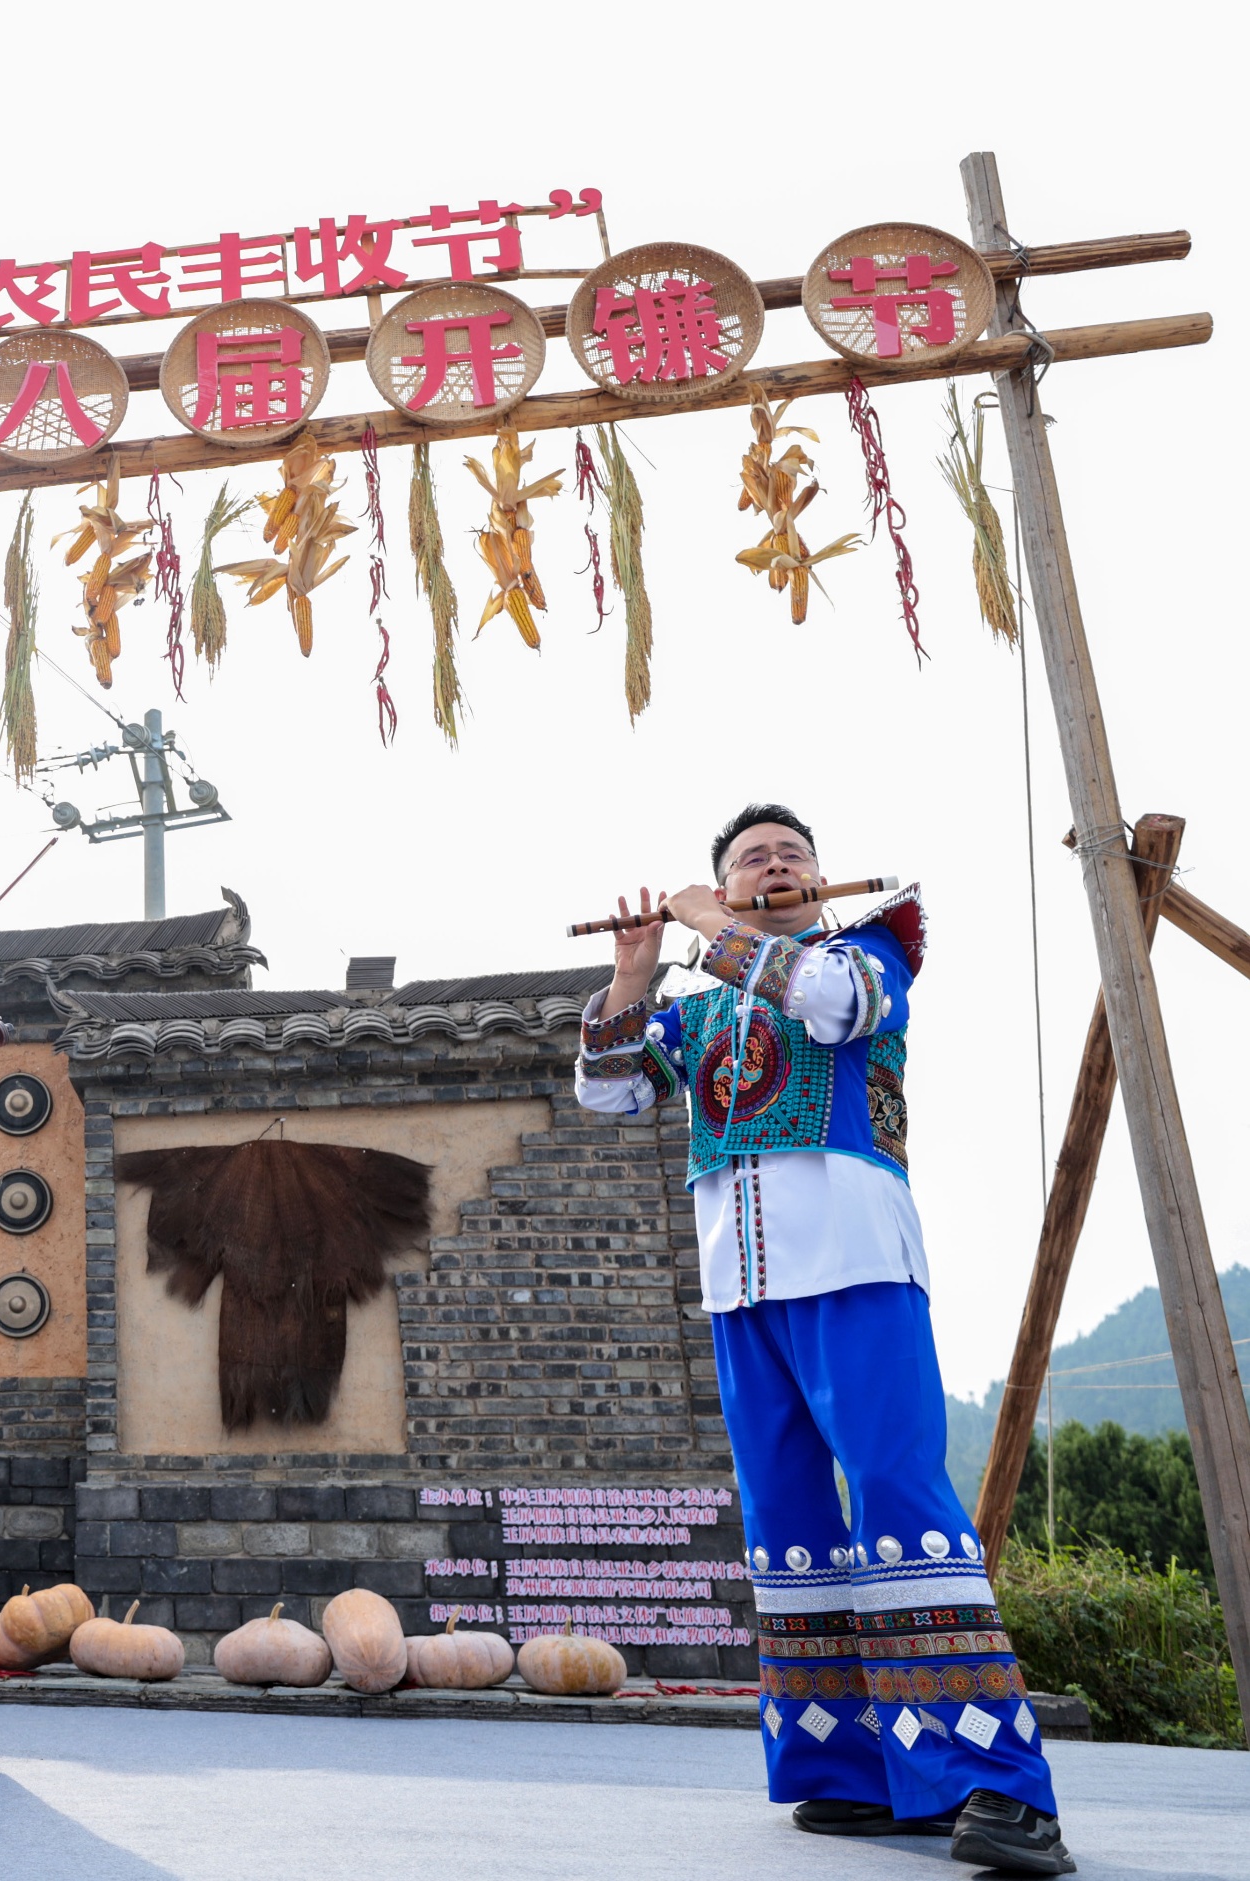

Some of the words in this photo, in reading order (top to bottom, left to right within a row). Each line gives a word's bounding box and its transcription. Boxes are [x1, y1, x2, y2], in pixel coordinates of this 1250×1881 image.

[499, 1487, 733, 1507] 中共玉屏侗族自治县亚鱼乡委员会
[501, 1507, 719, 1526] 玉屏侗族自治县亚鱼乡人民政府
[502, 1526, 691, 1545] 玉屏侗族自治县农业农村局
[506, 1578, 712, 1599] 贵州桃花源旅游管理有限公司
[508, 1604, 732, 1627] 玉屏侗族自治县文体广电旅游局
